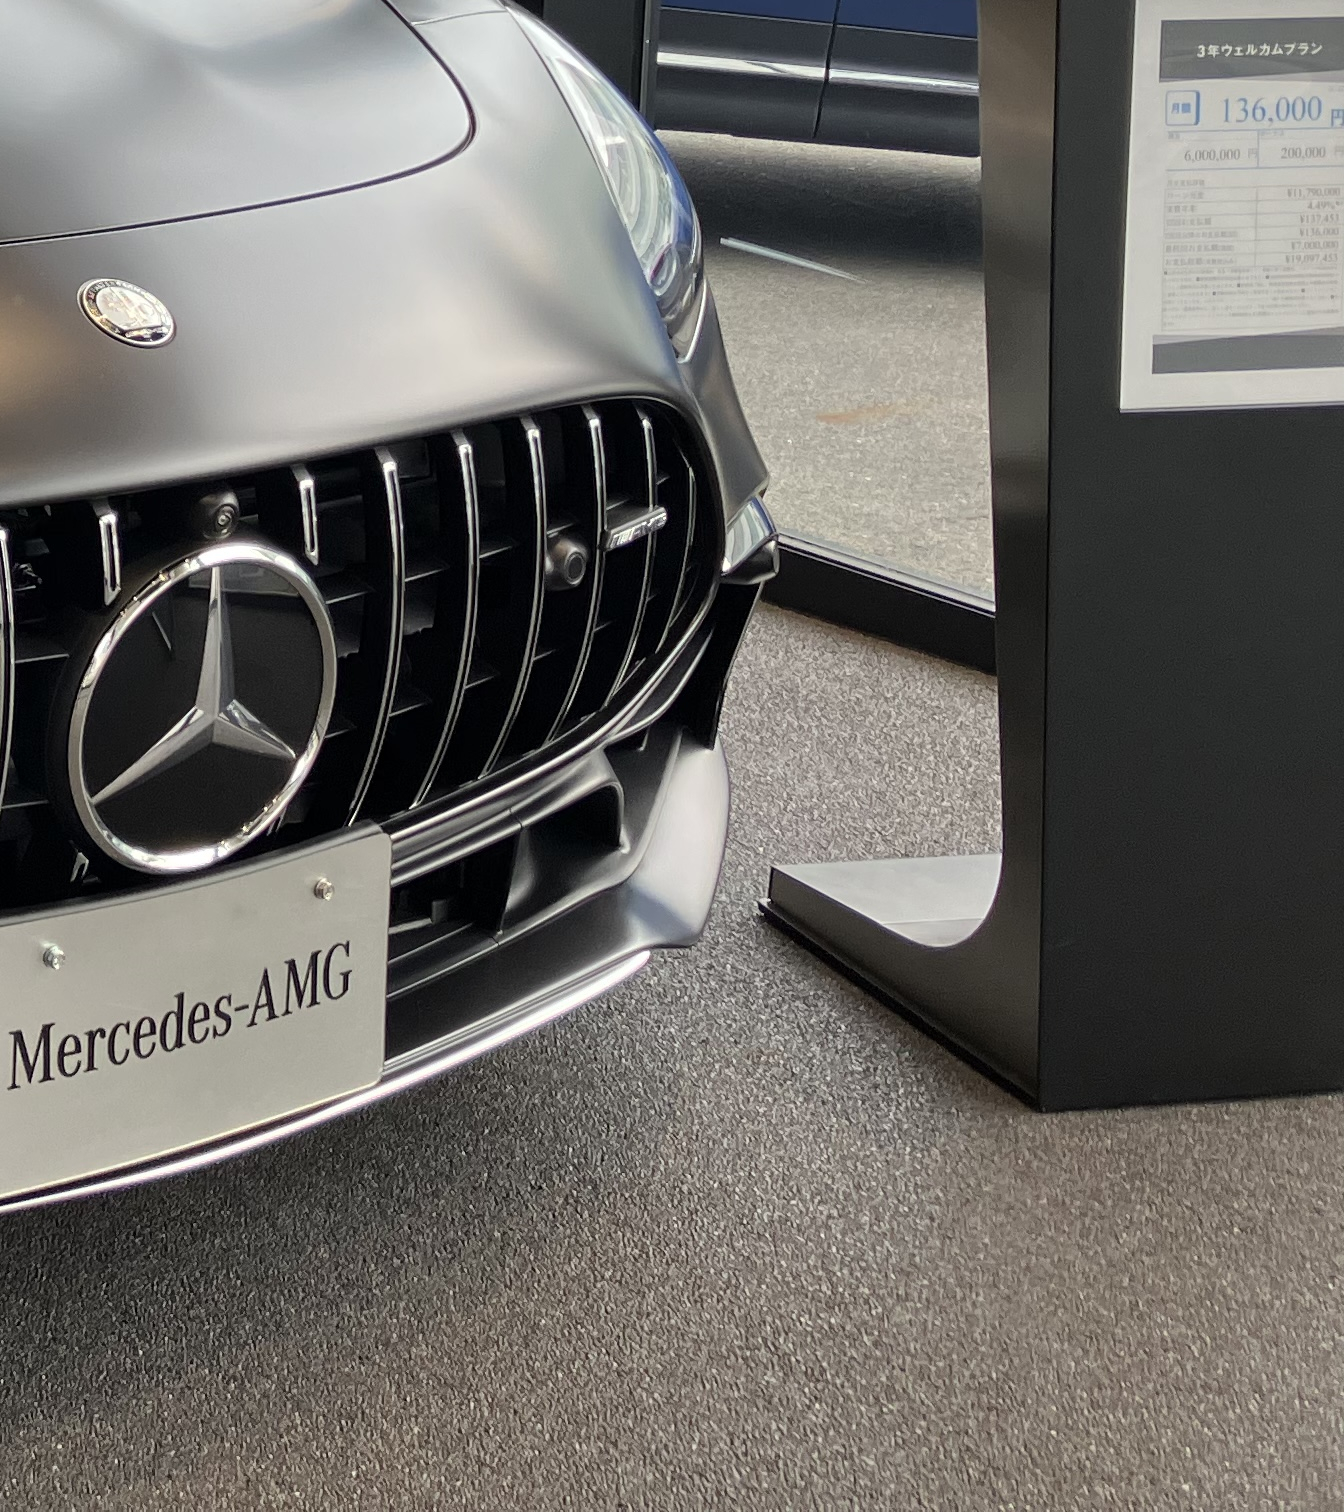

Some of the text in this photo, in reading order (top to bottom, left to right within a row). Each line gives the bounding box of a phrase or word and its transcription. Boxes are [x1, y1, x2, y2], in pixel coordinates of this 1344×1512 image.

[1223, 95, 1323, 126] 136,000
[1184, 148, 1241, 162] 6,000,000
[1280, 146, 1327, 159] 200,000
[6, 940, 353, 1091] Mercedes-AMG
